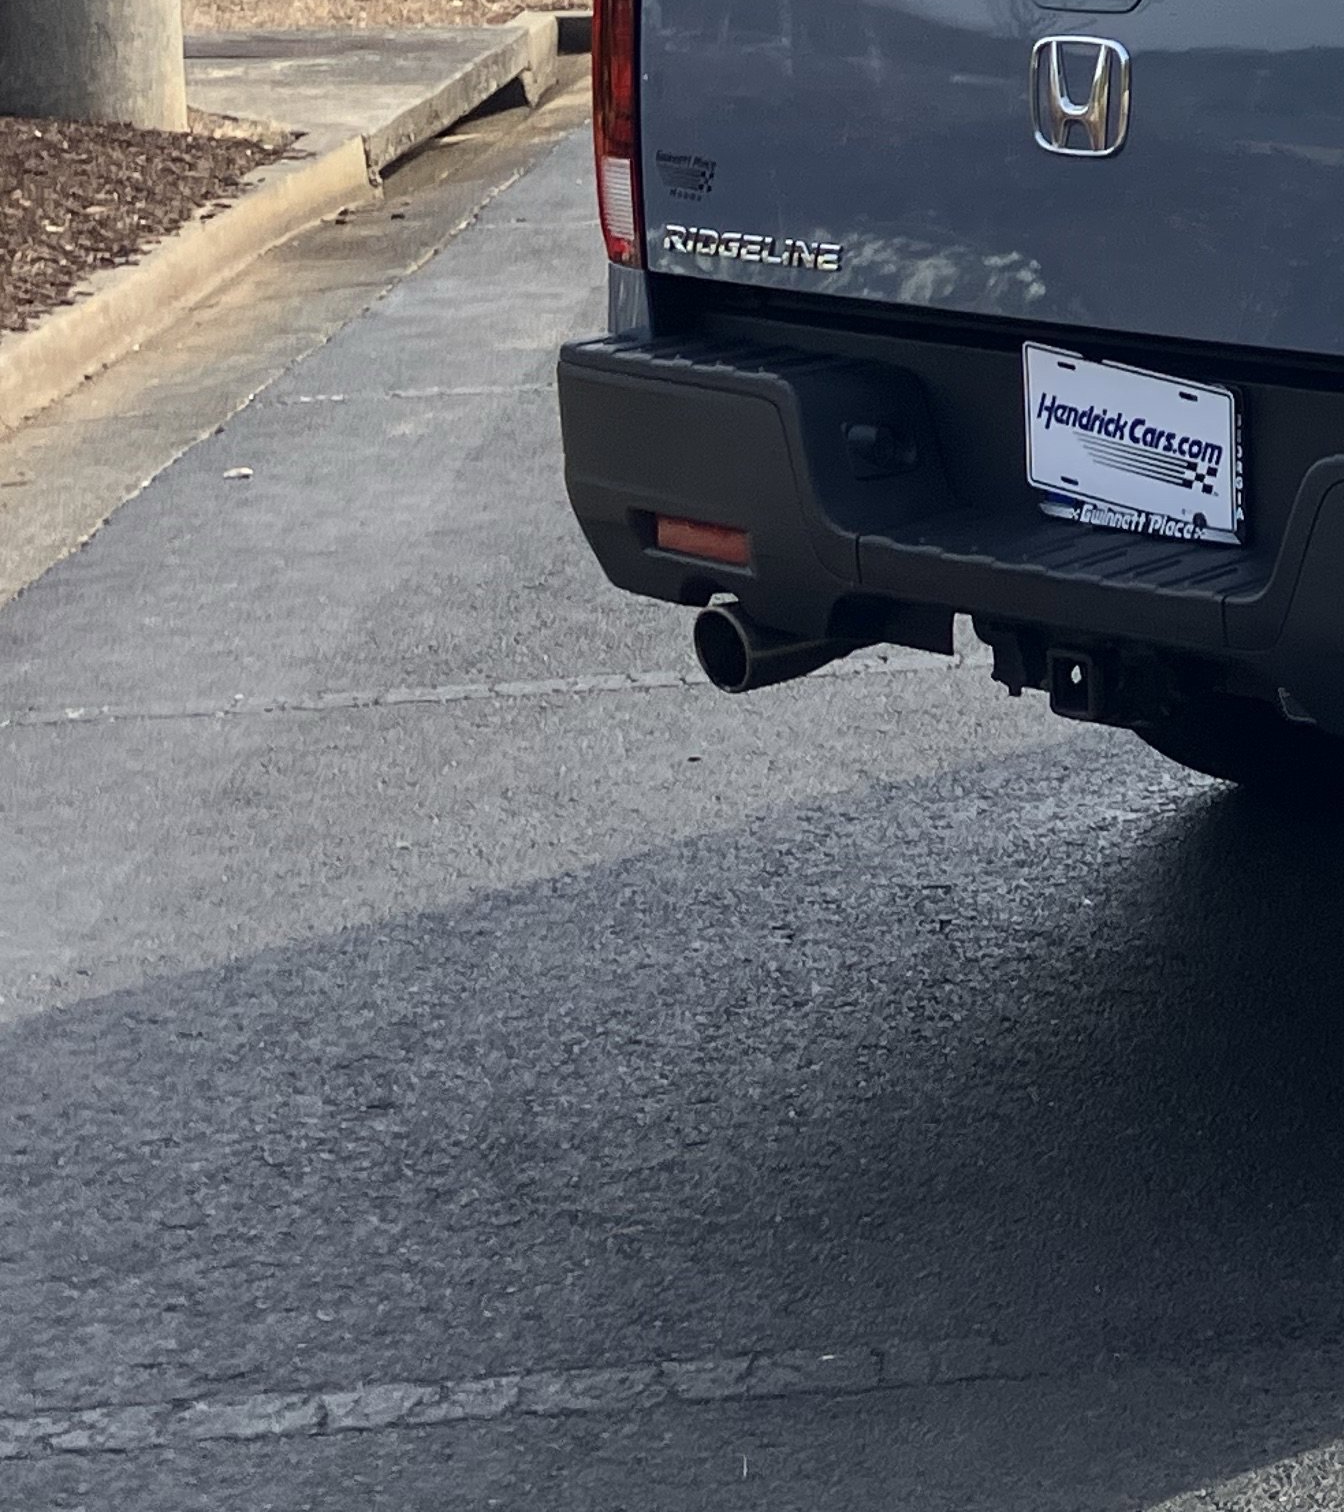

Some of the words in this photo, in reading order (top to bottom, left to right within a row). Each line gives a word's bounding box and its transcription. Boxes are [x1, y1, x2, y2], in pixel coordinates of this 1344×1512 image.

[663, 224, 843, 272] RIDGELINE
[1080, 503, 1146, 534] Gwinnett
[1147, 513, 1194, 539] Place
